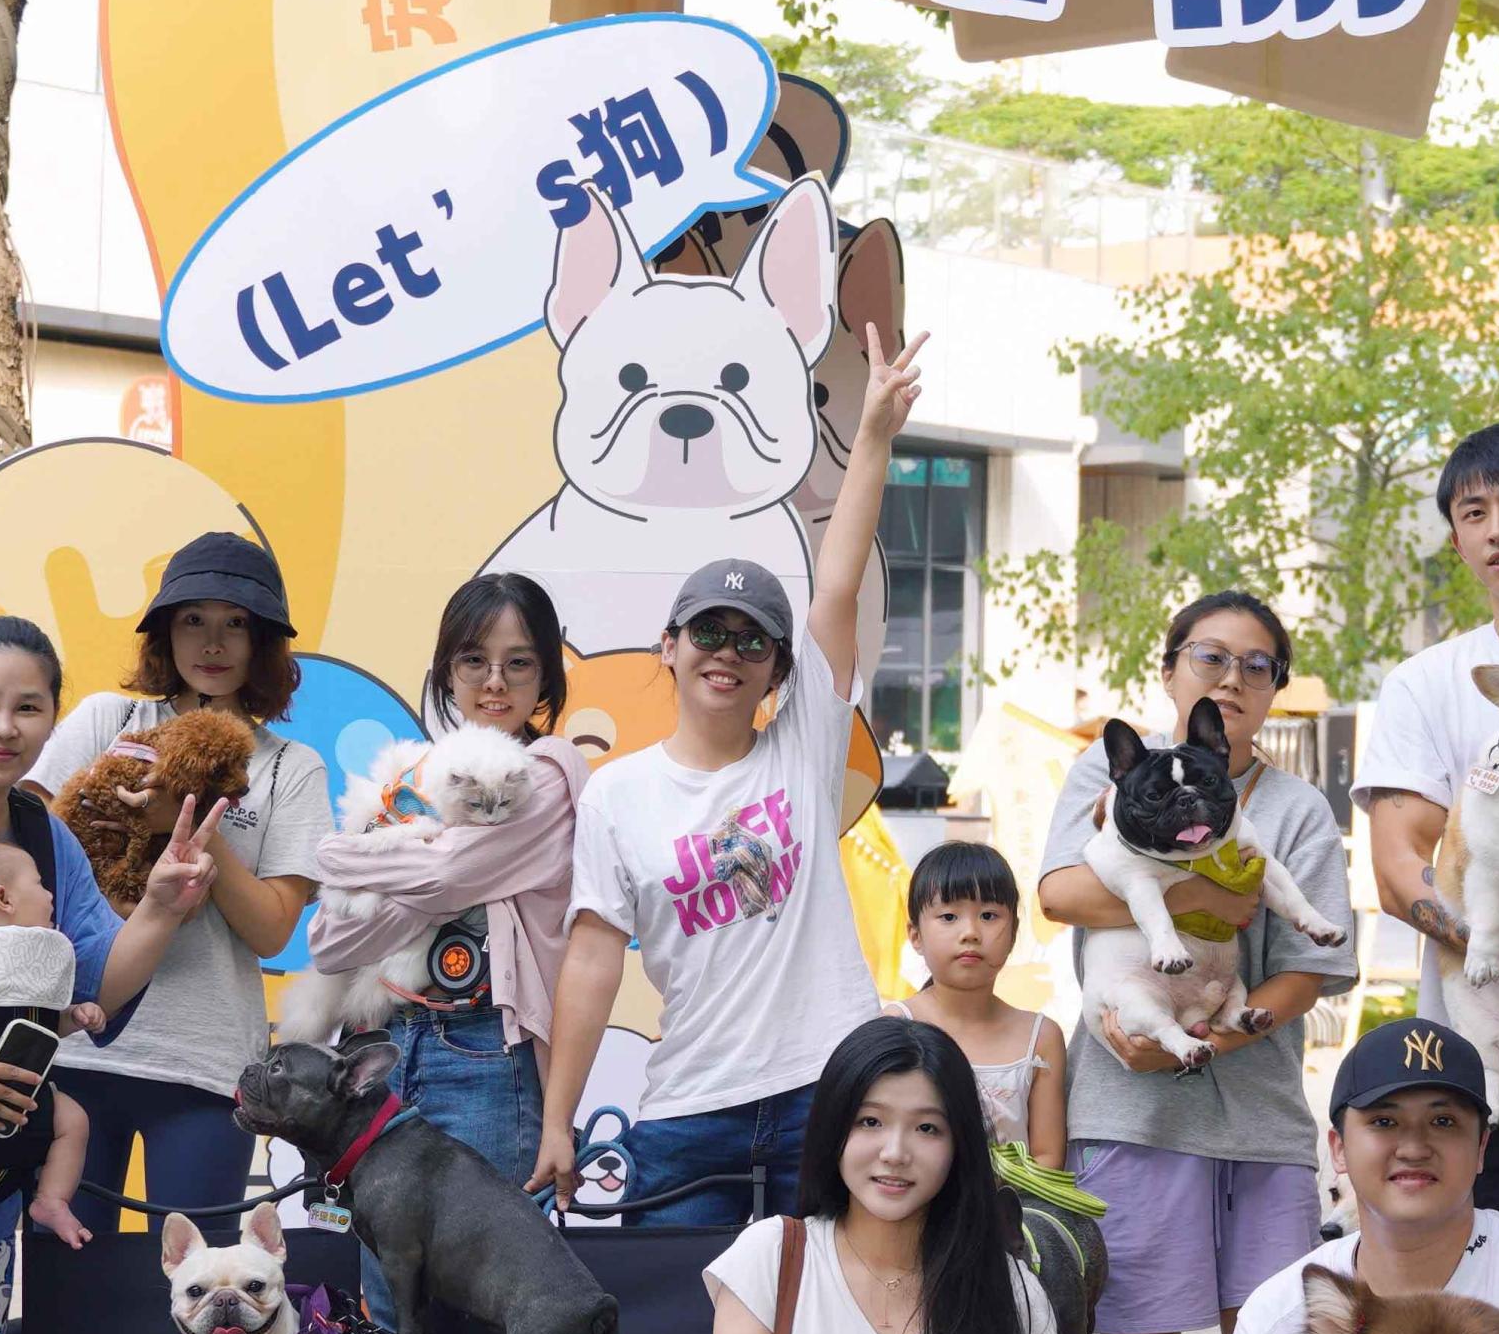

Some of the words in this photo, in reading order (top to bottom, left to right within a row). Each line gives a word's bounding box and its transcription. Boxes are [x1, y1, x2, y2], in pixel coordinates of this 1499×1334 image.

[724, 571, 745, 591] NY
[225, 805, 259, 823] A.P.C.
[1402, 1028, 1445, 1073] NY
